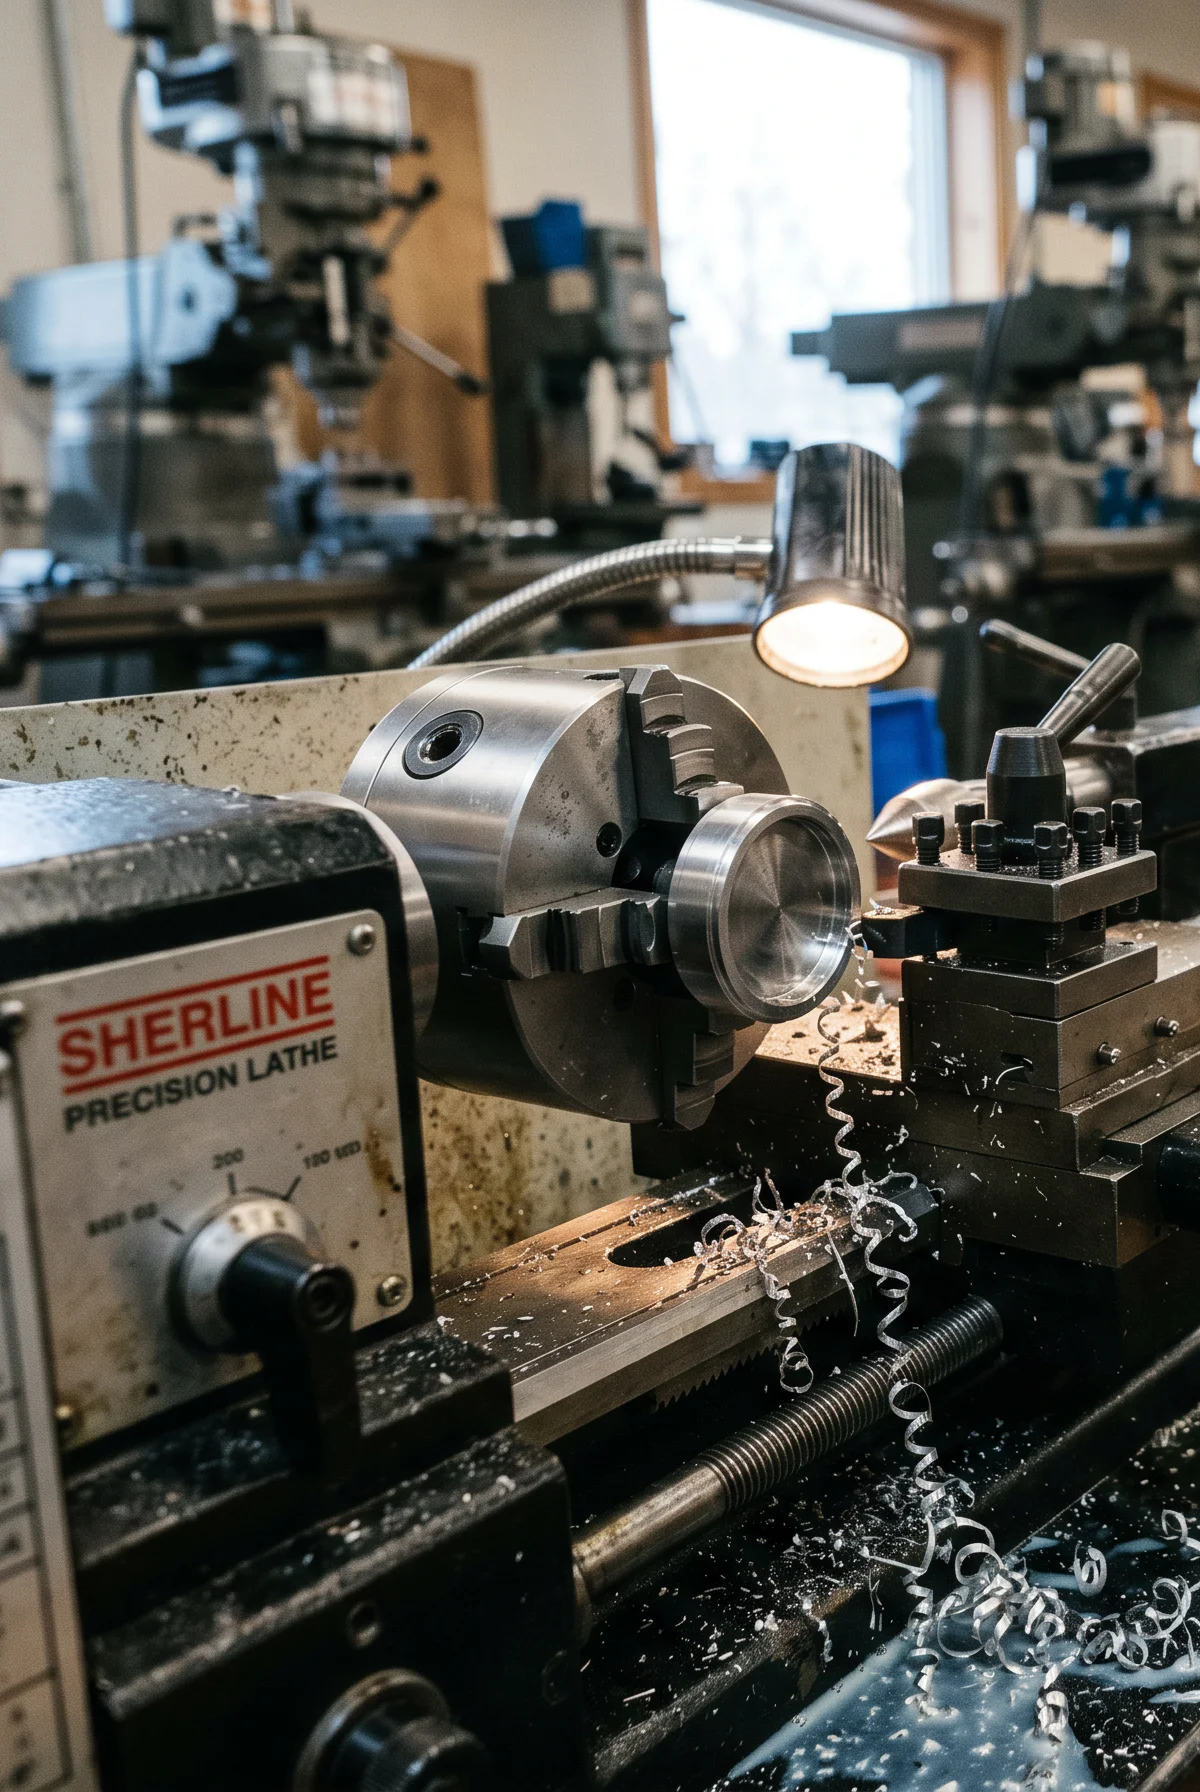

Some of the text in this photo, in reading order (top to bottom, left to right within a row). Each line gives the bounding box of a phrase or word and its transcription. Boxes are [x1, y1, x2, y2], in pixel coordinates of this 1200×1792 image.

[58, 971, 334, 1077] SHERLINE
[64, 1034, 339, 1132] PRECISION LATHE
